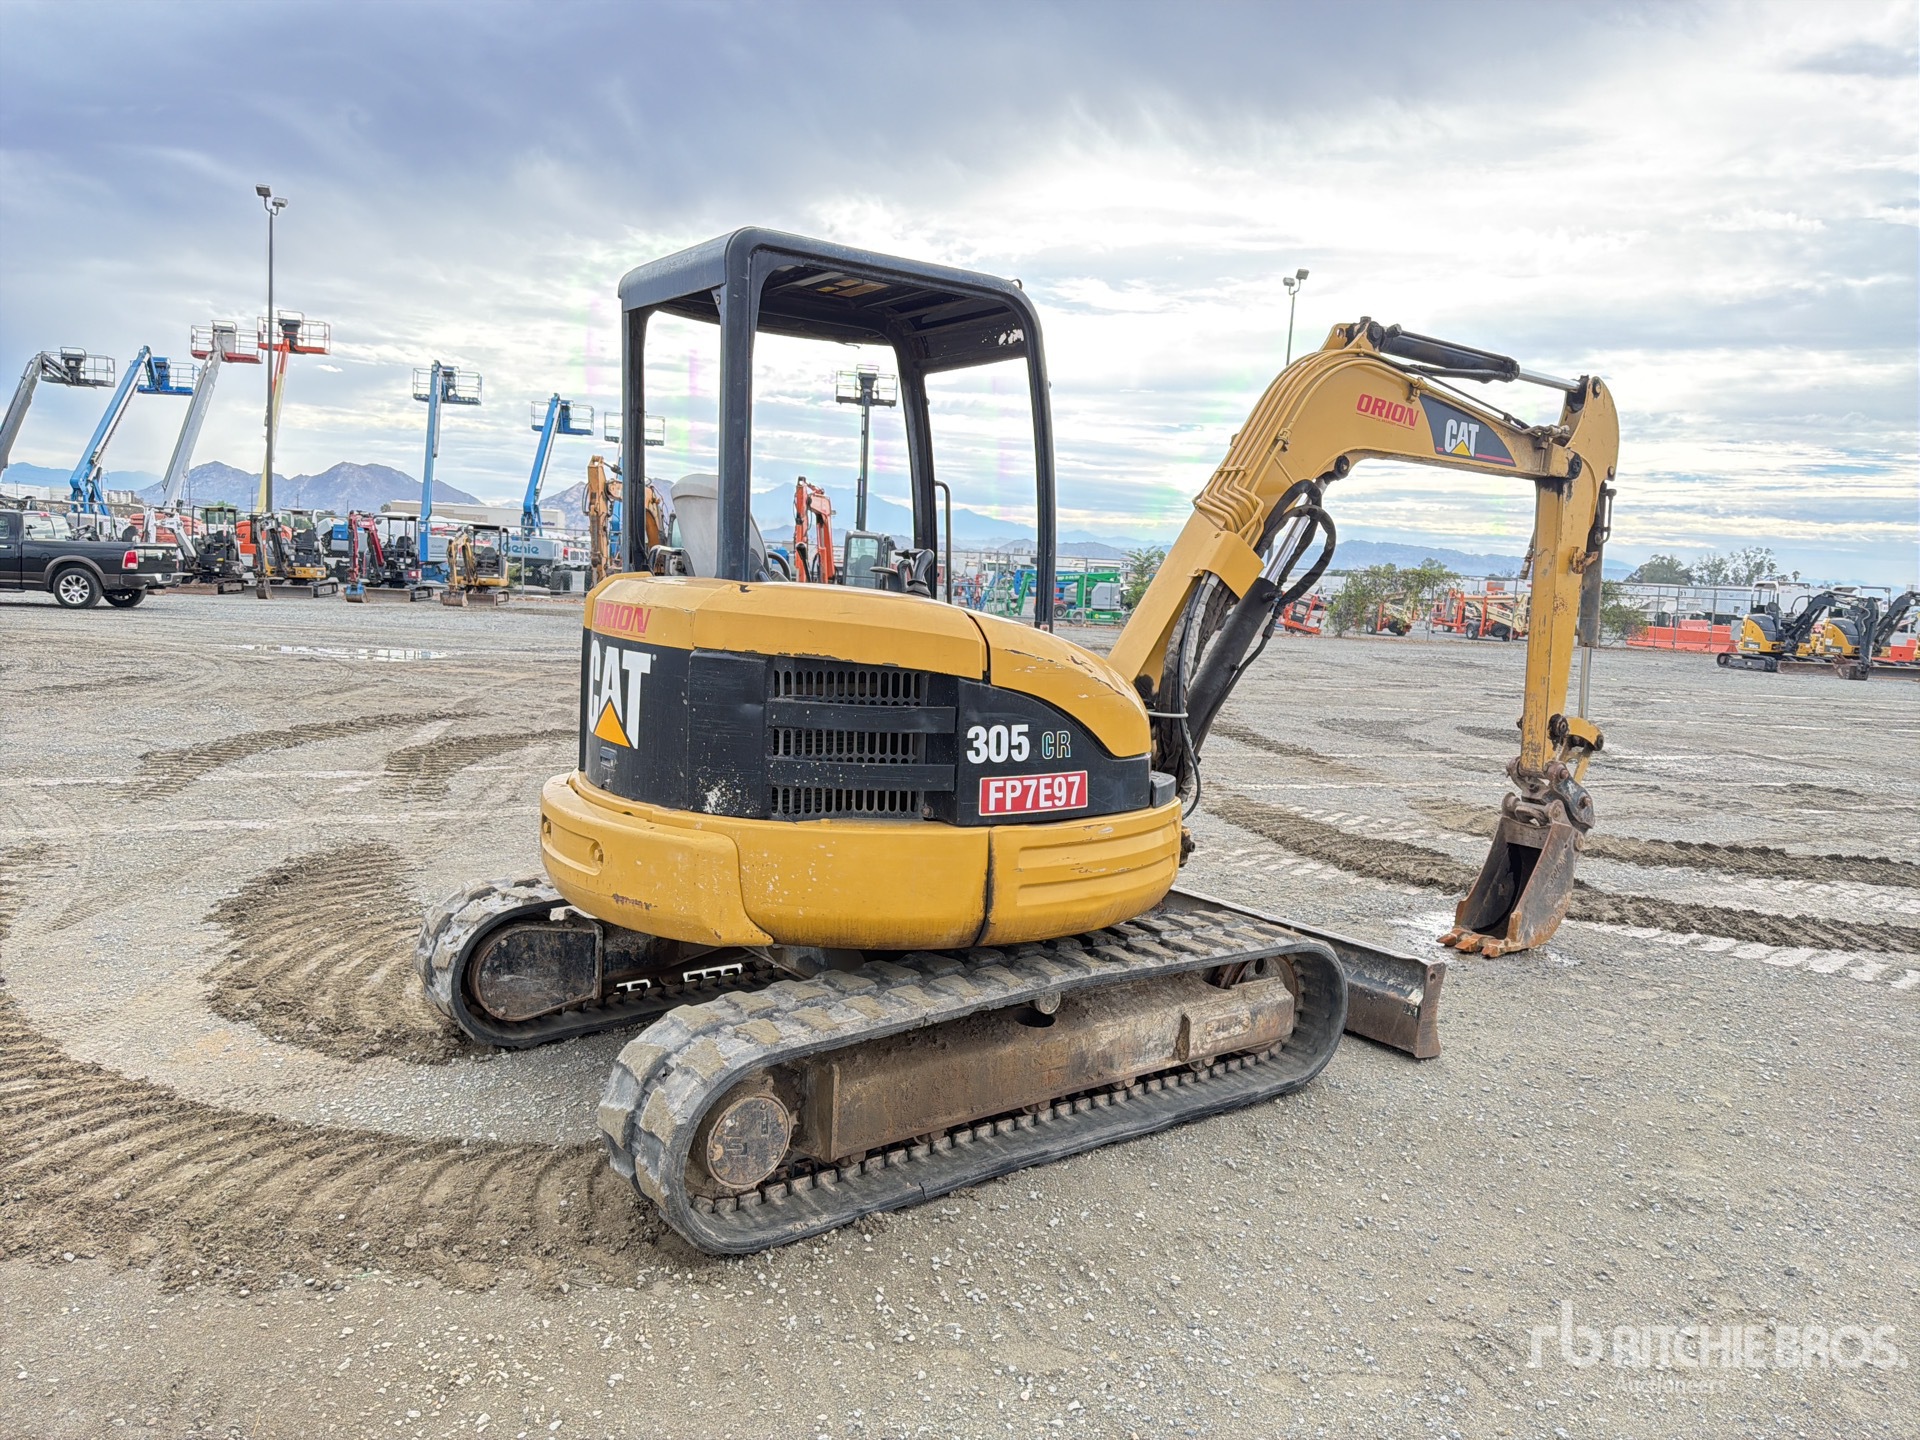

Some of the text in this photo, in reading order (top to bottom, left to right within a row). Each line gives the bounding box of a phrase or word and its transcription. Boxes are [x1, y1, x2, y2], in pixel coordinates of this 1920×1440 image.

[1356, 393, 1420, 427] ORION
[1444, 418, 1480, 457] CAT
[588, 638, 652, 750] CAT
[966, 723, 1072, 764] 305 CR
[988, 775, 1081, 812] FP7E97
